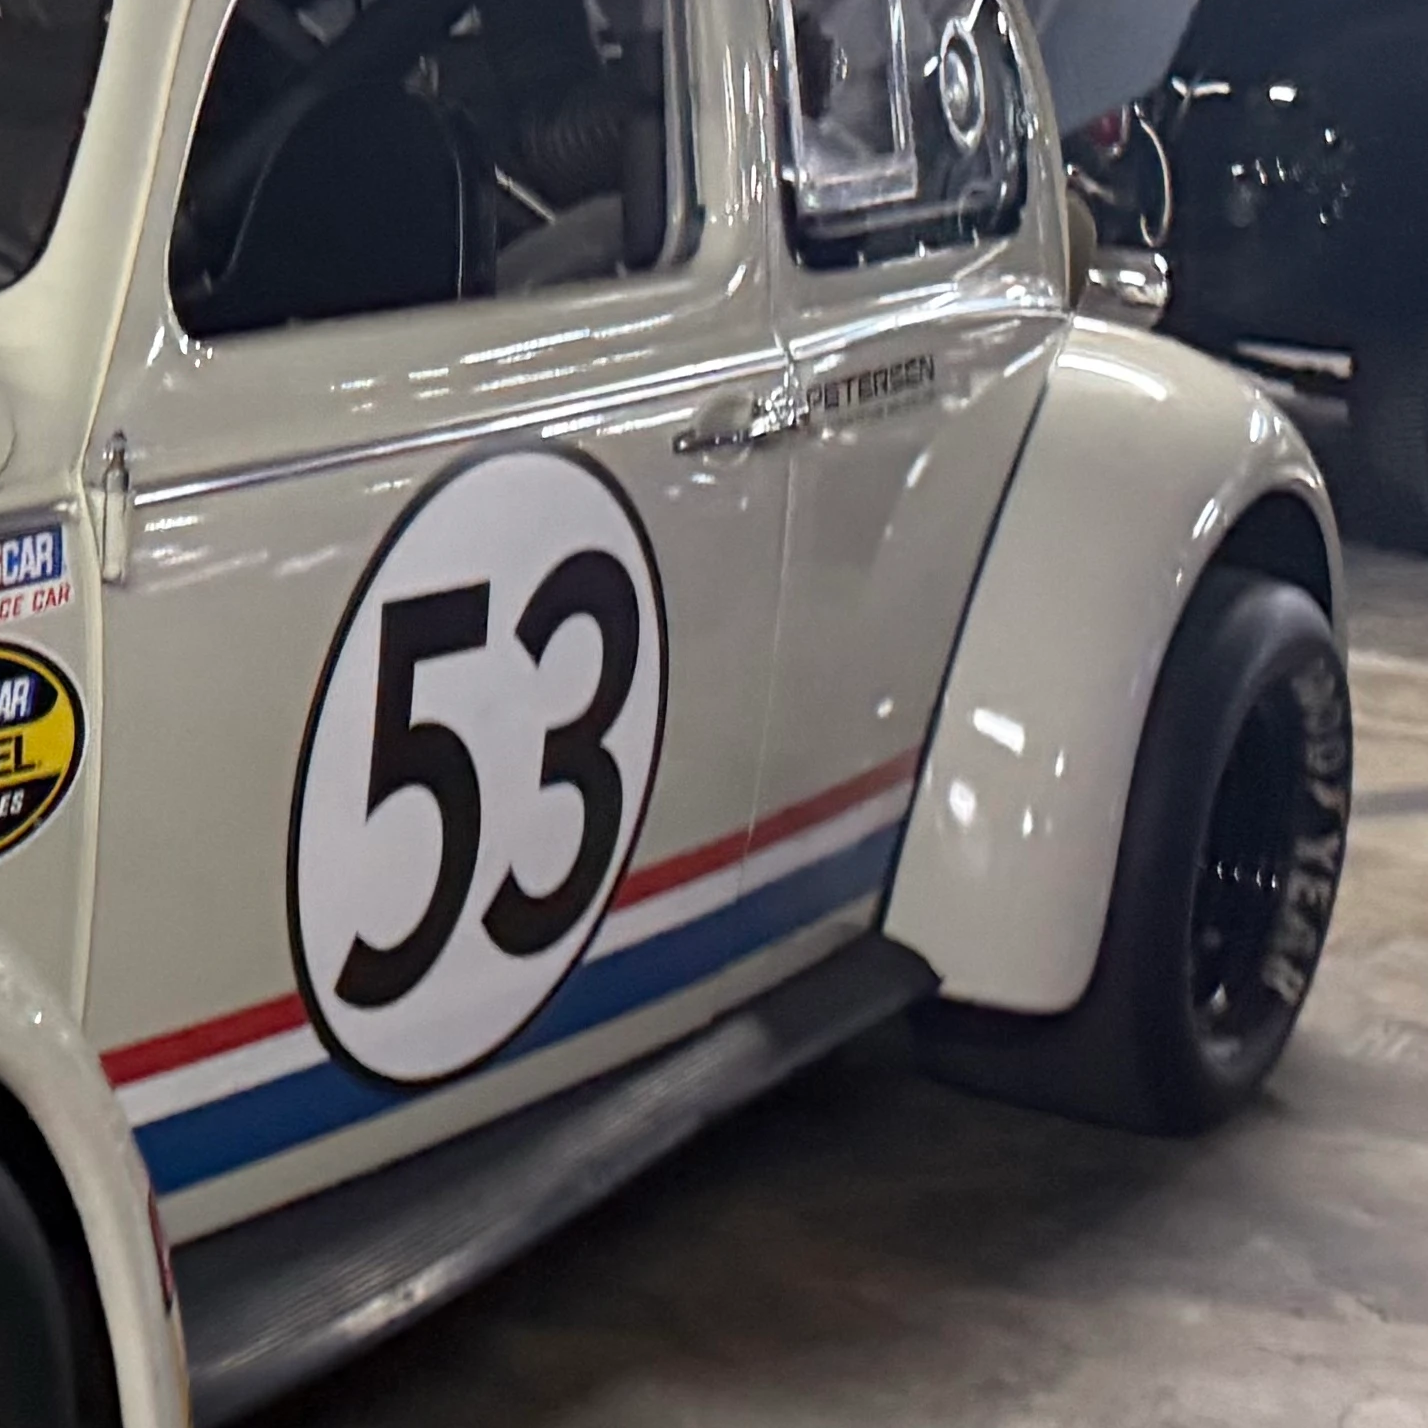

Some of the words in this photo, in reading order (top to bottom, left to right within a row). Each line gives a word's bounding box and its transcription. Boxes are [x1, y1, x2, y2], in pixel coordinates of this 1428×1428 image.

[806, 354, 935, 410] PETERSEN
[31, 584, 71, 613] CAR
[335, 550, 640, 1009] 53
